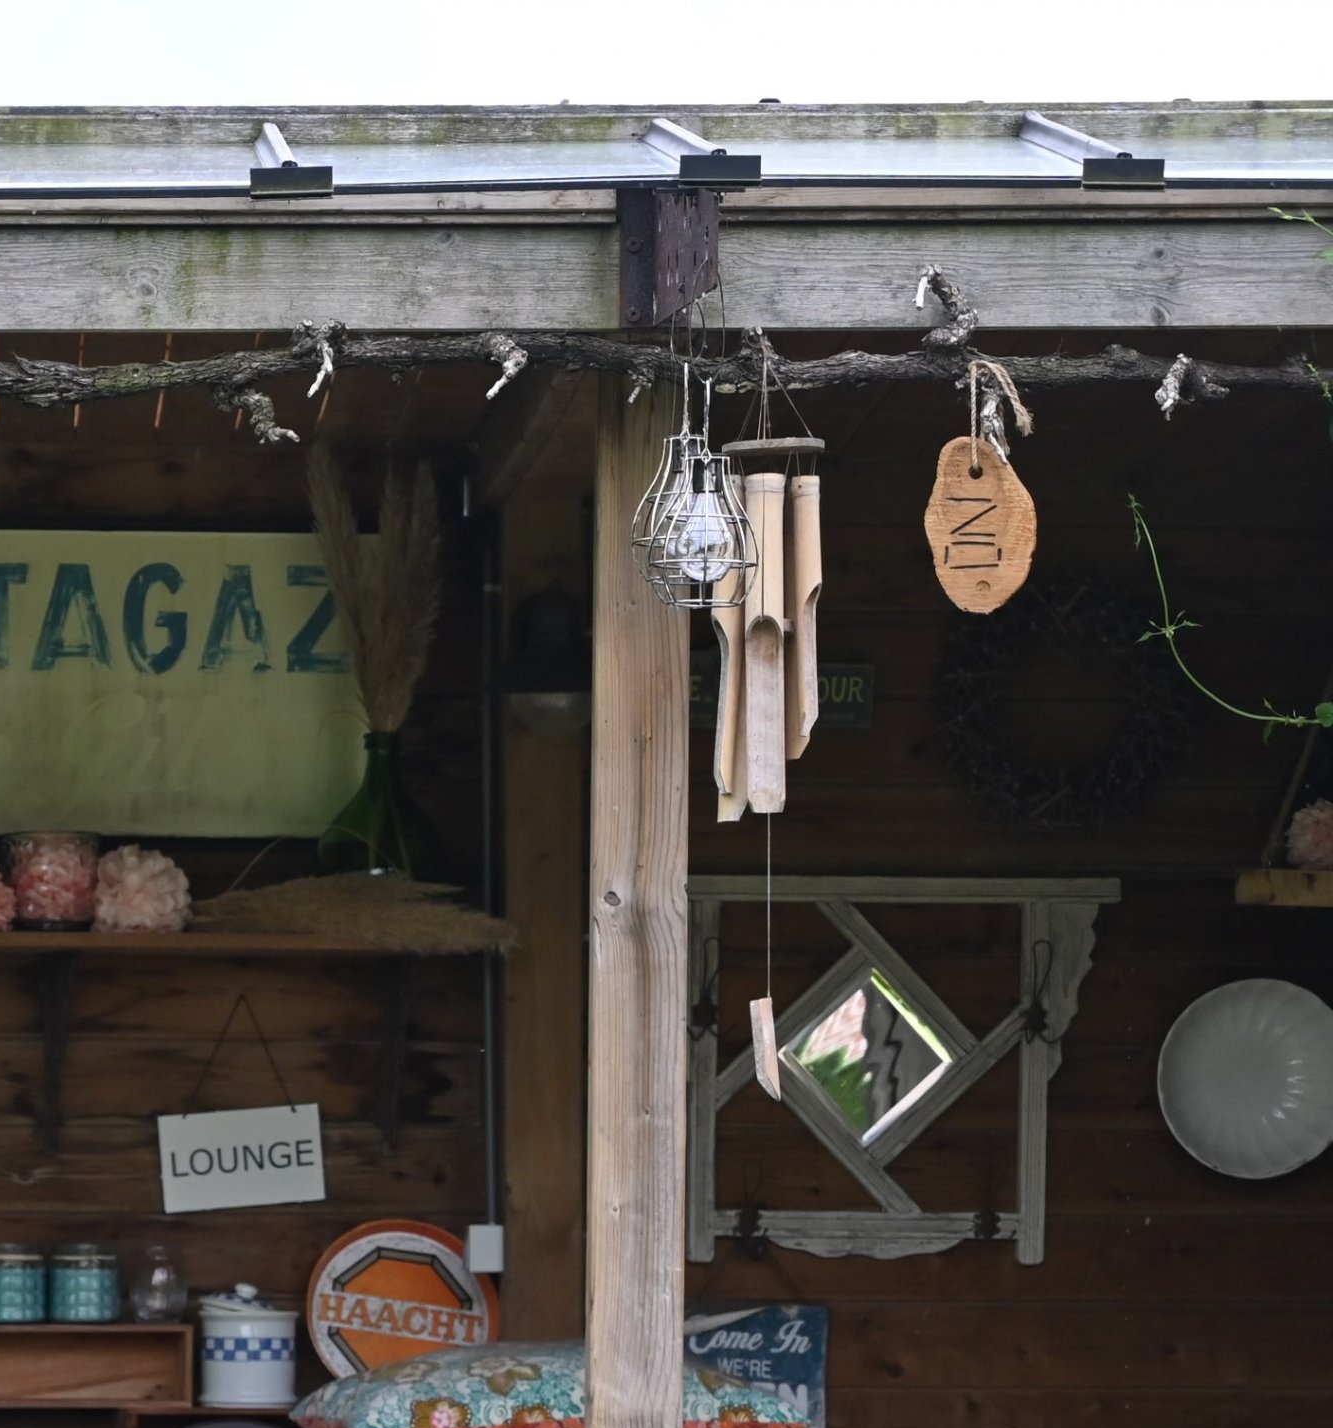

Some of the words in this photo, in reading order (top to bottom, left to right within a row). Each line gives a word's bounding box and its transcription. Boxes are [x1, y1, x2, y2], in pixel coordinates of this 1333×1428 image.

[170, 1139, 315, 1178] LOUNGE
[319, 1293, 482, 1343] HAACHT
[770, 1320, 813, 1354] In
[717, 1357, 773, 1379] WE'RE
